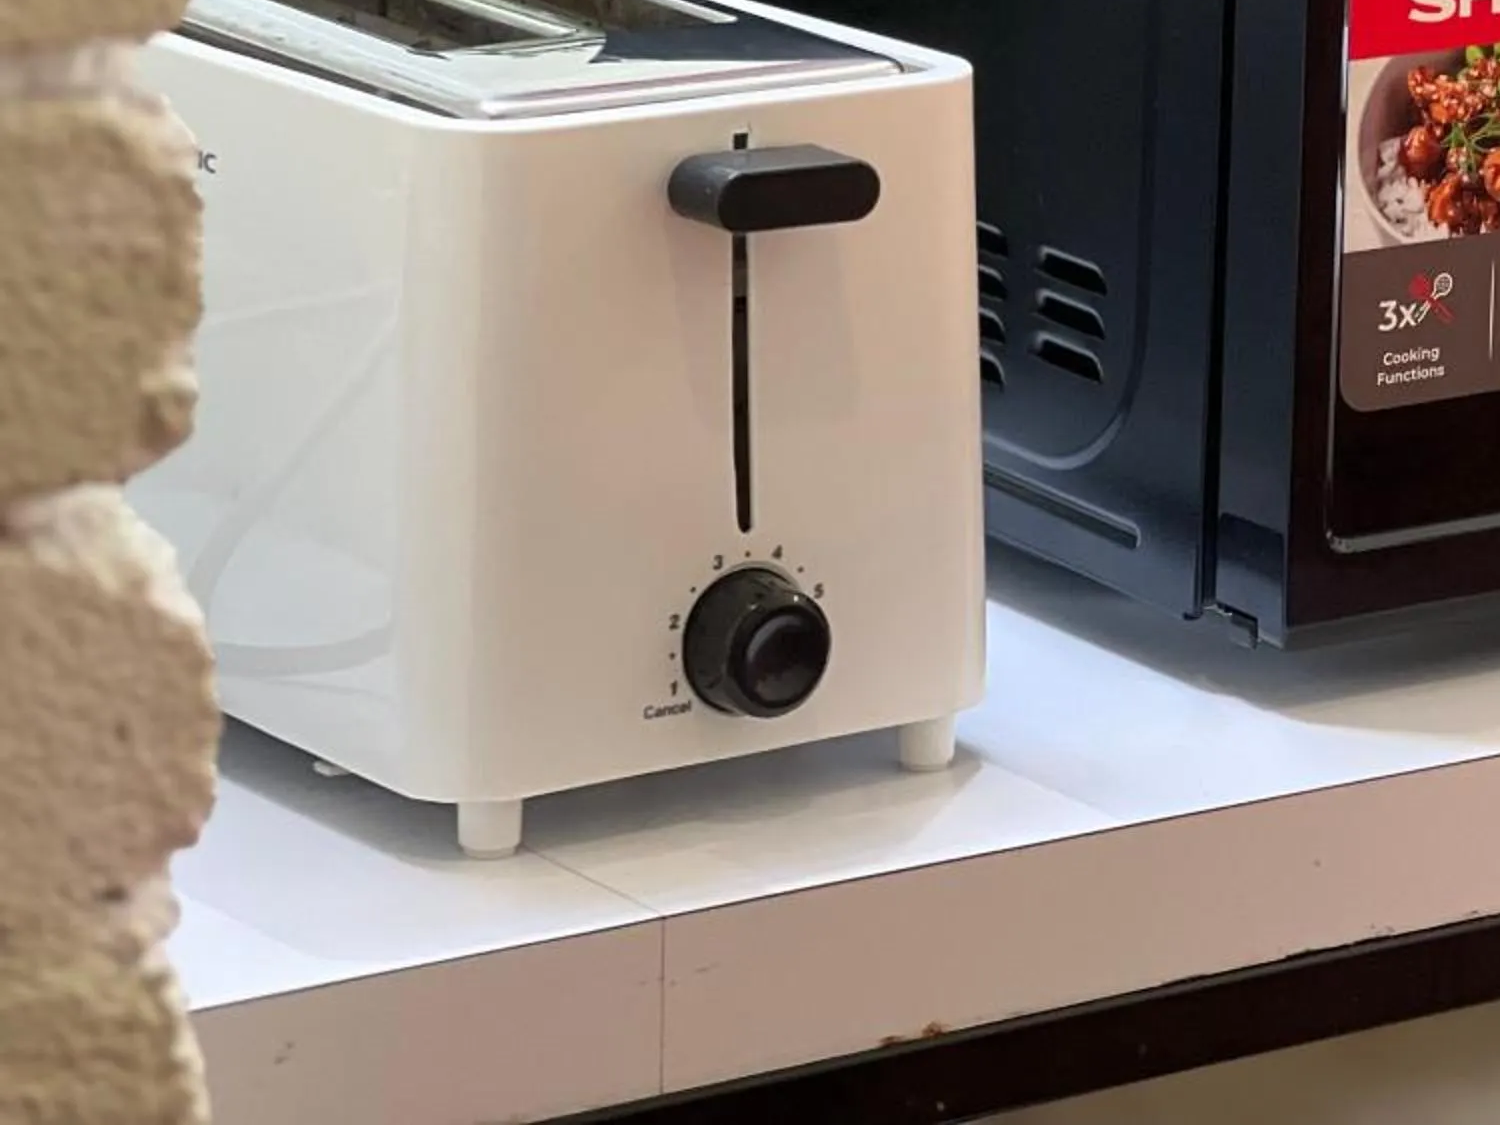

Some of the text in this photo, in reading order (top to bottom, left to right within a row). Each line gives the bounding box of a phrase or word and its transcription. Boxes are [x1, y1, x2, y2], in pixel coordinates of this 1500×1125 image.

[1377, 299, 1418, 332] 3x
[1382, 345, 1441, 367] Cooking
[1376, 363, 1445, 386] Functions
[771, 544, 783, 560] 4
[712, 554, 724, 571] 3
[813, 583, 825, 599] 5
[668, 613, 681, 631] 2
[669, 680, 678, 697] 1
[643, 699, 693, 720] Cancel
